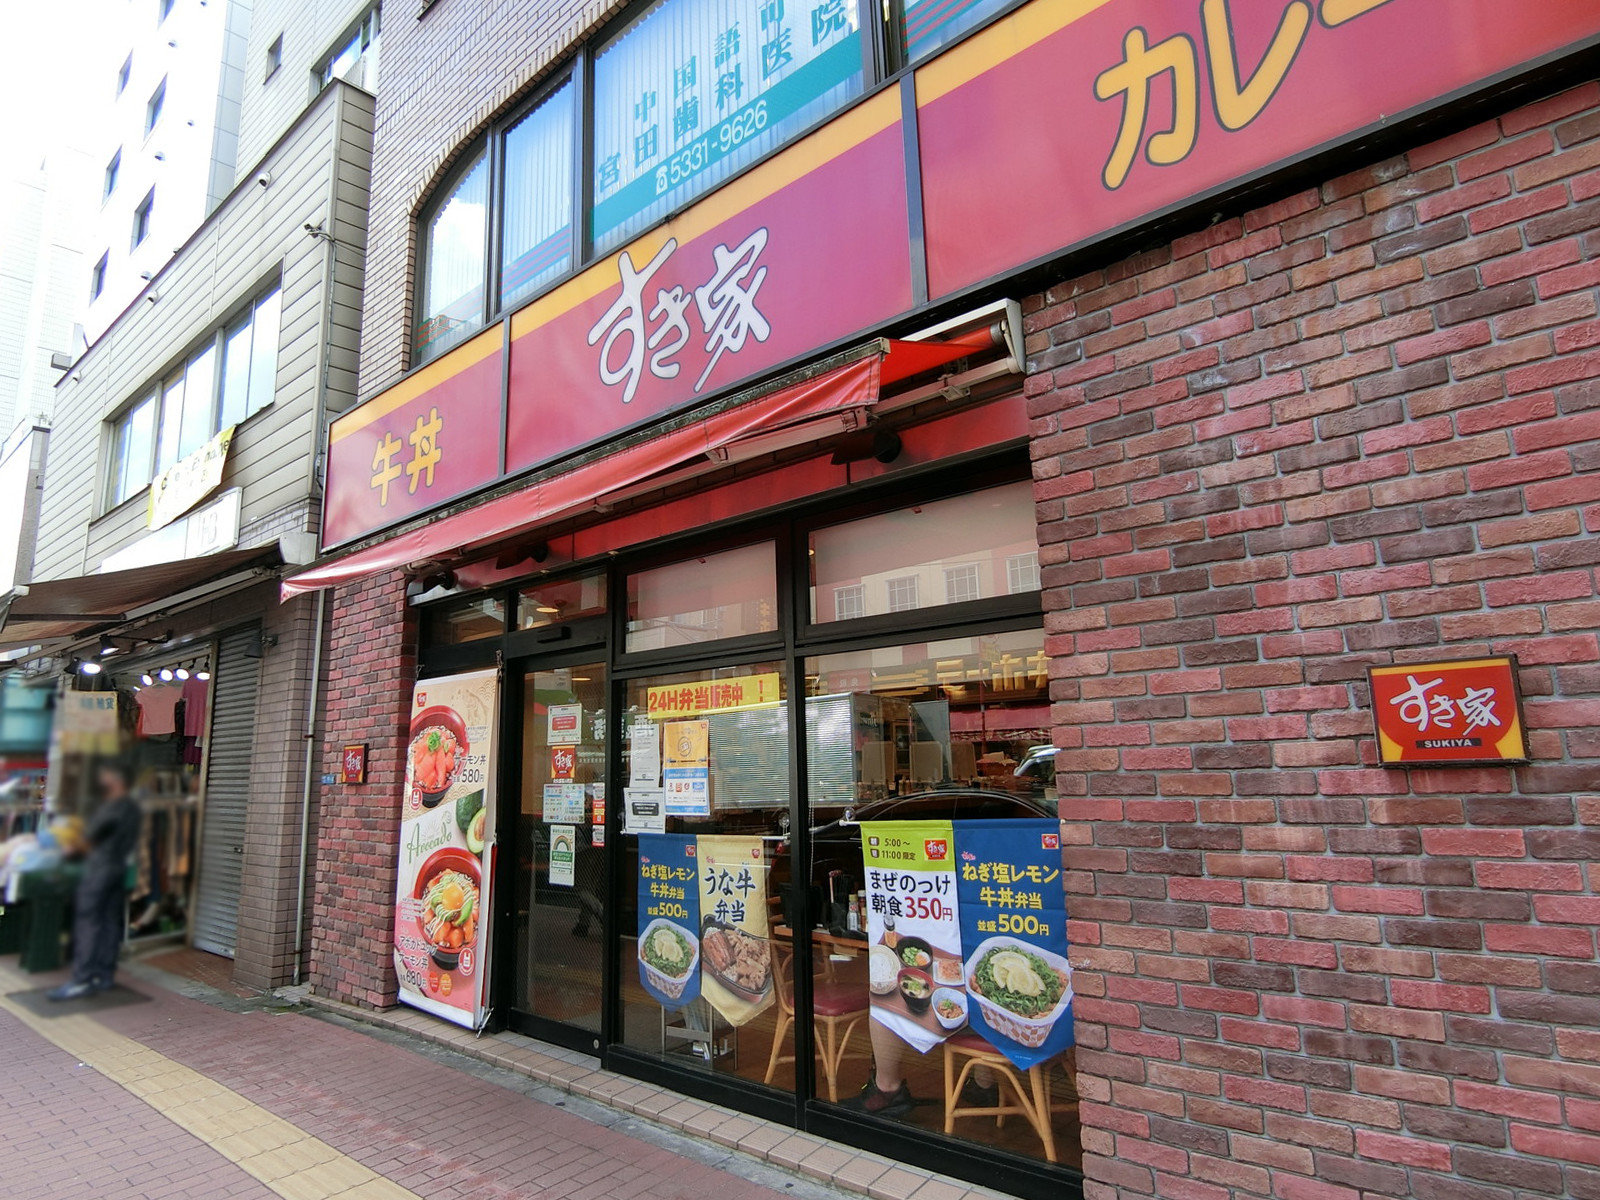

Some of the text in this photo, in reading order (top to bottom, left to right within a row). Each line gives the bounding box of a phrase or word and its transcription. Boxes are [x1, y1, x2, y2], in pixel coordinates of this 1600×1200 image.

[670, 100, 767, 184] 5331-9626
[587, 226, 772, 403] すき家
[370, 406, 443, 508] 牛丼
[1389, 675, 1502, 736] すき家
[1423, 739, 1473, 749] SUKIYA
[641, 864, 696, 881] ねぎ塩レモン
[704, 867, 757, 899] うな牛
[870, 870, 951, 896] まぜのっけ
[962, 862, 1060, 884] ねぎ塩レモン
[650, 882, 685, 900] 牛丼弁当
[980, 886, 1043, 910] 牛丼弁当
[714, 899, 746, 925] 弁当
